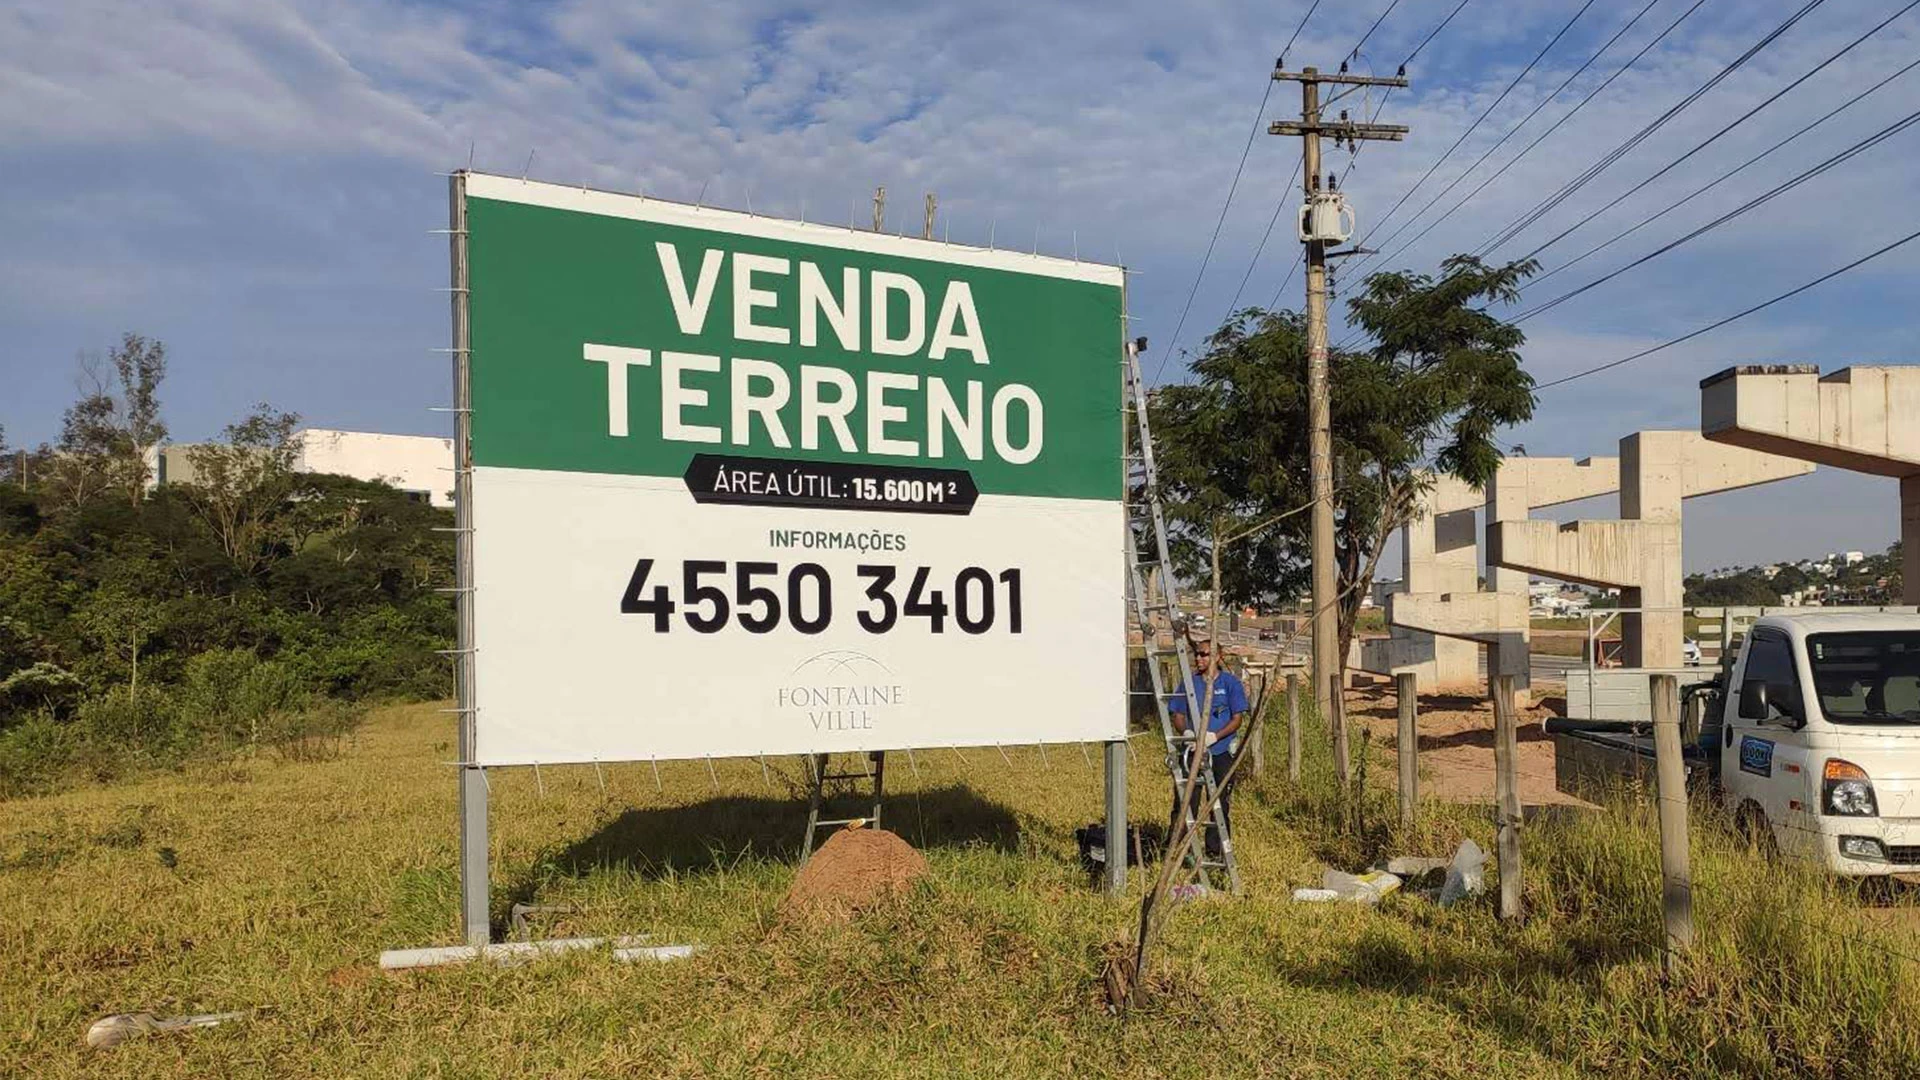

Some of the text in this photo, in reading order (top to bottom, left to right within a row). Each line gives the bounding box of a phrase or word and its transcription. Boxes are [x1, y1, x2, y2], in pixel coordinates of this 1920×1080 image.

[655, 242, 990, 365] VENDA
[583, 343, 1044, 465] TERRENO
[713, 464, 781, 495] ÁREA
[787, 468, 849, 498] ÚTIL:
[769, 529, 907, 554] INFORMAÇÕES
[620, 558, 1023, 635] 4550 3401
[778, 685, 902, 708] FONTAINE
[809, 710, 873, 732] VILLE
